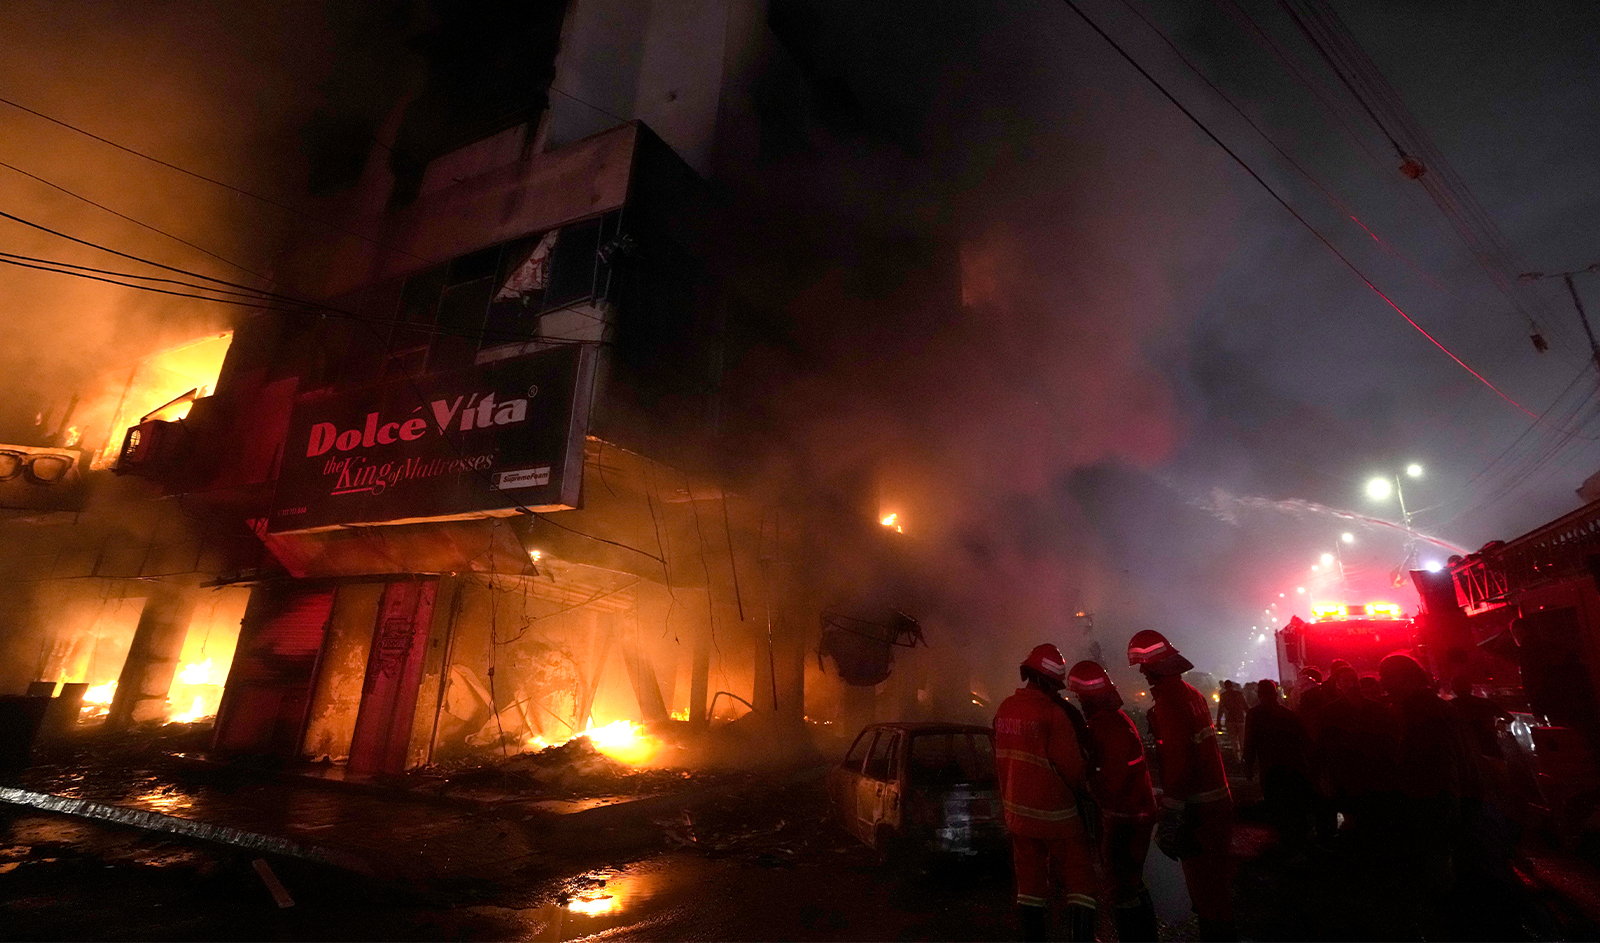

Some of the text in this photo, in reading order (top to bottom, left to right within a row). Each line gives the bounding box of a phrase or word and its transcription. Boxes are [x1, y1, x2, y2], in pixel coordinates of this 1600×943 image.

[306, 391, 528, 457] Dolcé Víta
[323, 454, 494, 495] the King of Mattresses
